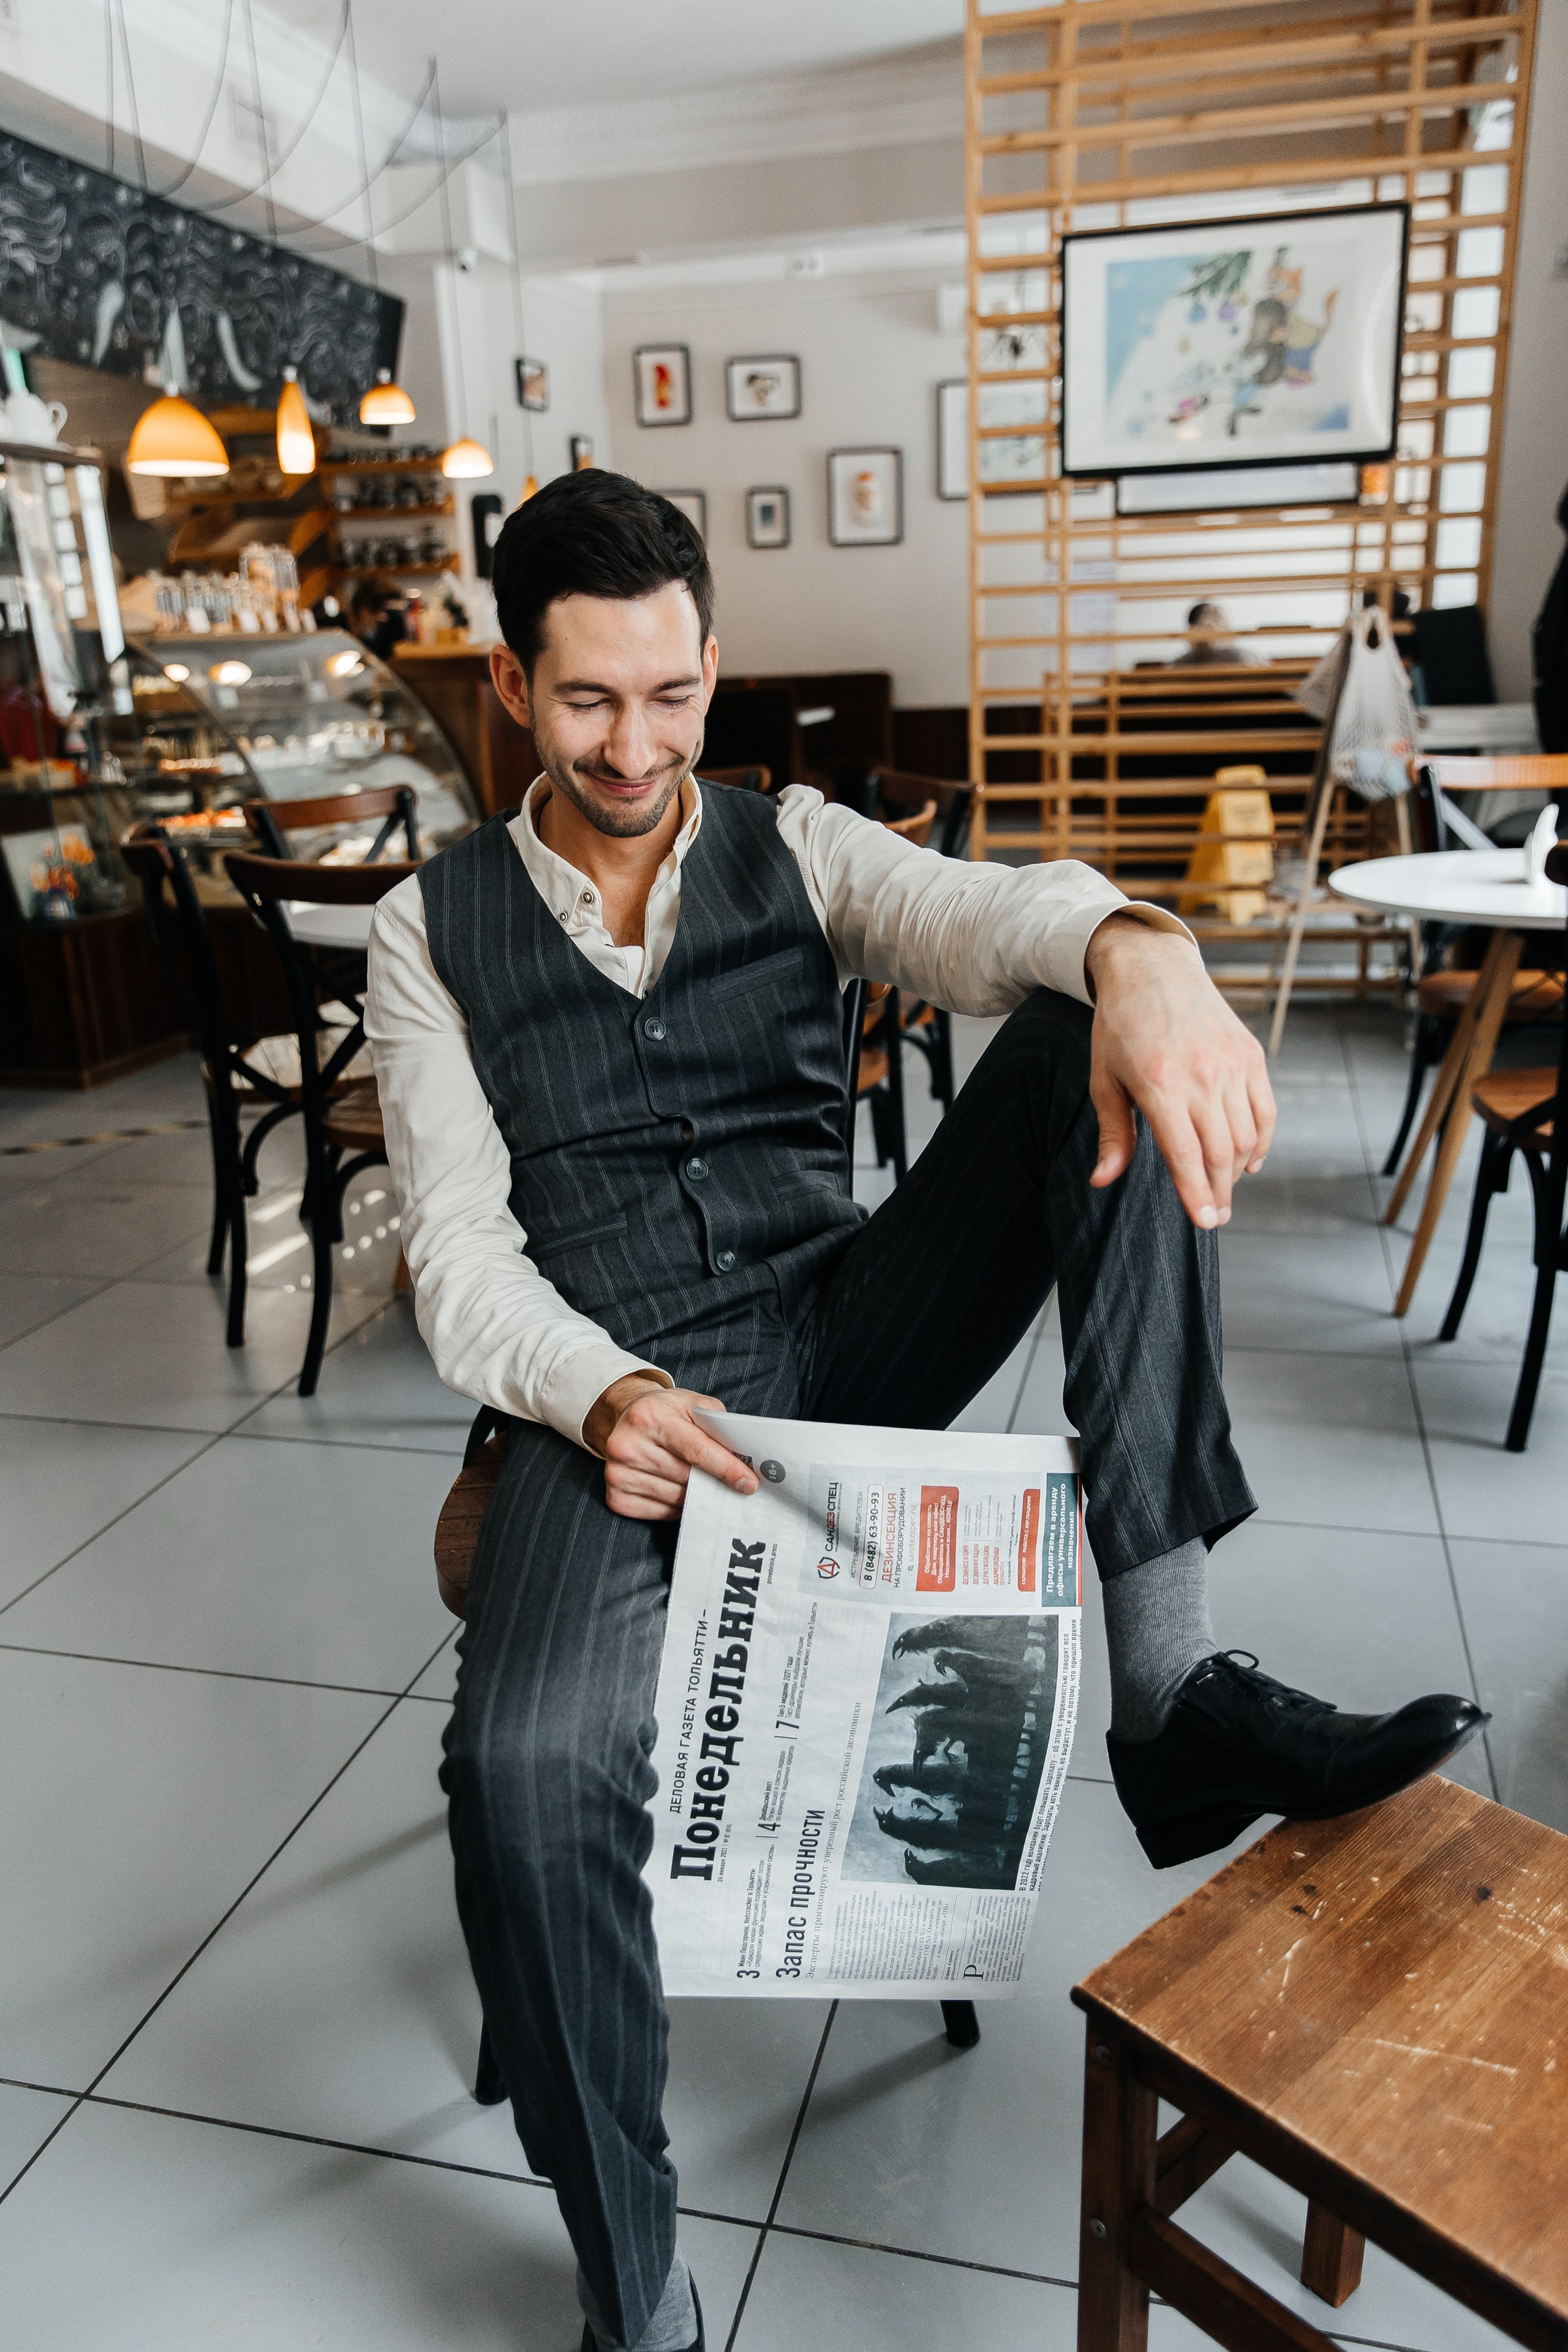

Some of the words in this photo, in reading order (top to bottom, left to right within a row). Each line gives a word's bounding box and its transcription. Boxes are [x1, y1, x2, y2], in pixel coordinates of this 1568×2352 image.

[768, 1463, 778, 1480] 16+
[854, 1491, 863, 1534] ВРЕДИТЕЛЕЙ
[869, 1492, 880, 1537] 63-90-93
[1050, 1487, 1058, 1521] аренду
[894, 1487, 906, 1575] ПРОФОБОРУДОВАНИИ
[908, 1505, 916, 1562] sandezspec.ru
[1058, 1483, 1066, 1561] универсального
[881, 1493, 897, 1583] ДЕЗИНСЕКЦИЯ
[850, 1535, 860, 1578] ИСТРЕБЛЕНИЕ
[865, 1541, 878, 1572] (8482)
[1046, 1532, 1056, 1593] Предлагаем
[894, 1577, 901, 1588] НА
[1056, 1563, 1065, 1596] офисы
[795, 1688, 805, 1719] автомобили,
[800, 1667, 809, 1688] которые
[808, 1602, 818, 1624] Тольятти
[777, 1705, 786, 1717] Топ-5
[782, 1669, 791, 1681] 2021
[785, 1681, 798, 1718] Тест-драйверы
[792, 1657, 801, 1679] выбрали
[1057, 1675, 1068, 1721] уверенностью
[1068, 1683, 1077, 1708] потому,
[669, 1752, 688, 1813] ДЕЛОВАЯ
[679, 1698, 697, 1747] ГАЗЕТА
[688, 1621, 708, 1692] ТОЛЬЯТТИ
[670, 1537, 766, 1881] Понедельник
[775, 1720, 800, 1729] 7
[1061, 1725, 1072, 1755] вырастут,
[766, 1806, 775, 1820] Регион
[777, 1751, 786, 1769] лидеров
[781, 1766, 790, 1790] выданных
[1045, 1760, 1058, 1785] зарплату
[1052, 1765, 1066, 1791] немного,
[759, 1792, 771, 1820] Декабрьский
[777, 1791, 787, 1815] количеству
[1038, 1787, 1050, 1814] повышать
[1049, 1792, 1058, 1804] хоть
[757, 1822, 781, 1832] 4
[1033, 1815, 1043, 1830] будут
[1041, 1806, 1055, 1831] Зарплаты
[805, 1934, 820, 1978] Эксперты
[813, 1864, 828, 1931] прогнозируют
[823, 1822, 838, 1863] уверенный
[832, 1803, 842, 1819] рост
[837, 1752, 851, 1801] российской
[846, 1702, 861, 1749] экономики
[1027, 1831, 1039, 1857] компании
[1035, 1833, 1048, 1862] аналитики.
[790, 1809, 826, 1909] прочности
[1024, 1858, 1033, 1871] году
[747, 1868, 756, 1891] Тольятти:
[755, 1875, 763, 1902] порождает
[1019, 1872, 1029, 1885] 2022
[1029, 1863, 1040, 1891] кадровые
[743, 1896, 753, 1923] Netcracker
[750, 1902, 760, 1926] функция
[755, 1939, 764, 1967] следующих
[763, 1863, 772, 1894] усложнению
[739, 1924, 751, 1953] Подгорнов,
[775, 1916, 807, 1978] Запас
[737, 1954, 746, 1966] Иван
[746, 1944, 755, 1967] «Каждая
[736, 1970, 760, 1978] 3
